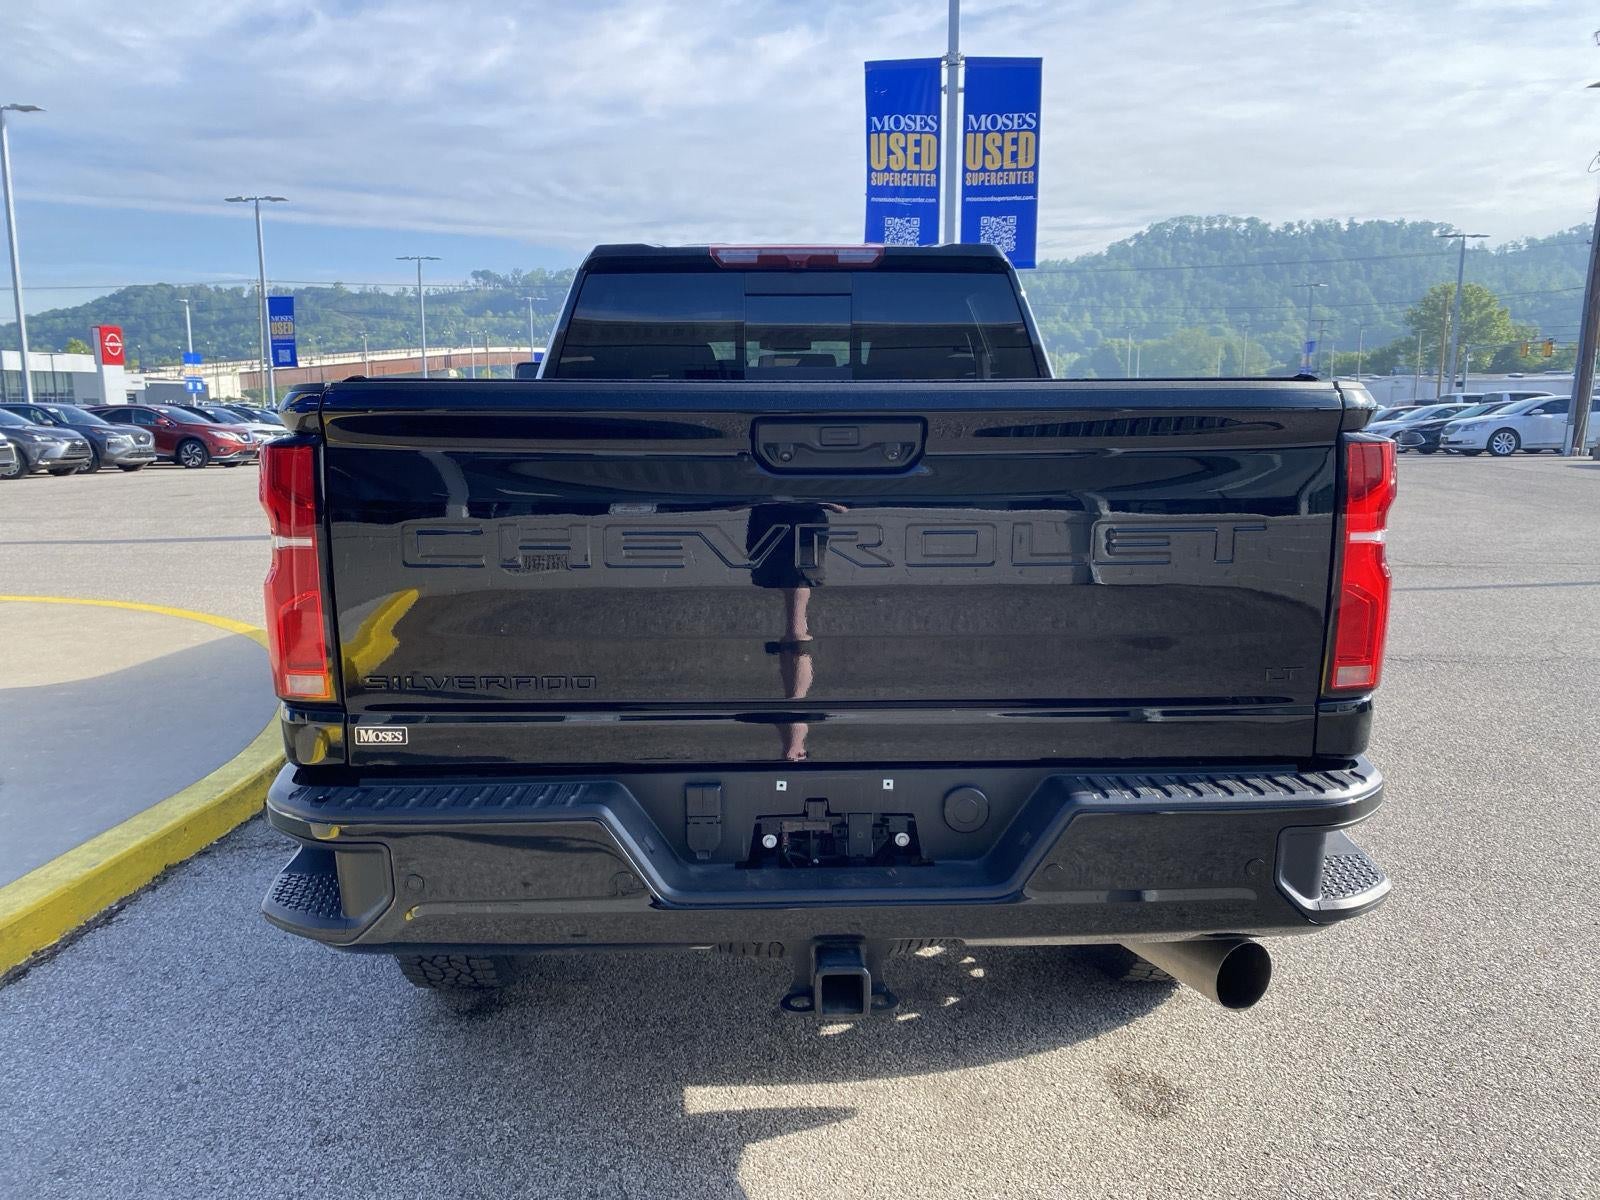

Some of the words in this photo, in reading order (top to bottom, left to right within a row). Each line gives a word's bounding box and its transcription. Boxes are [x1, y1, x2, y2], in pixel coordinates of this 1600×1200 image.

[871, 114, 938, 132] MOSES
[967, 112, 1037, 131] MOSES
[870, 132, 937, 171] USED
[965, 131, 1036, 170] USED
[871, 172, 937, 187] SUPERCENTER
[965, 171, 1034, 186] SUPERCENTER
[271, 321, 294, 335] USED
[402, 519, 1267, 568] CHEVROLET
[364, 675, 597, 690] SILVERADO
[1264, 666, 1304, 682] LT
